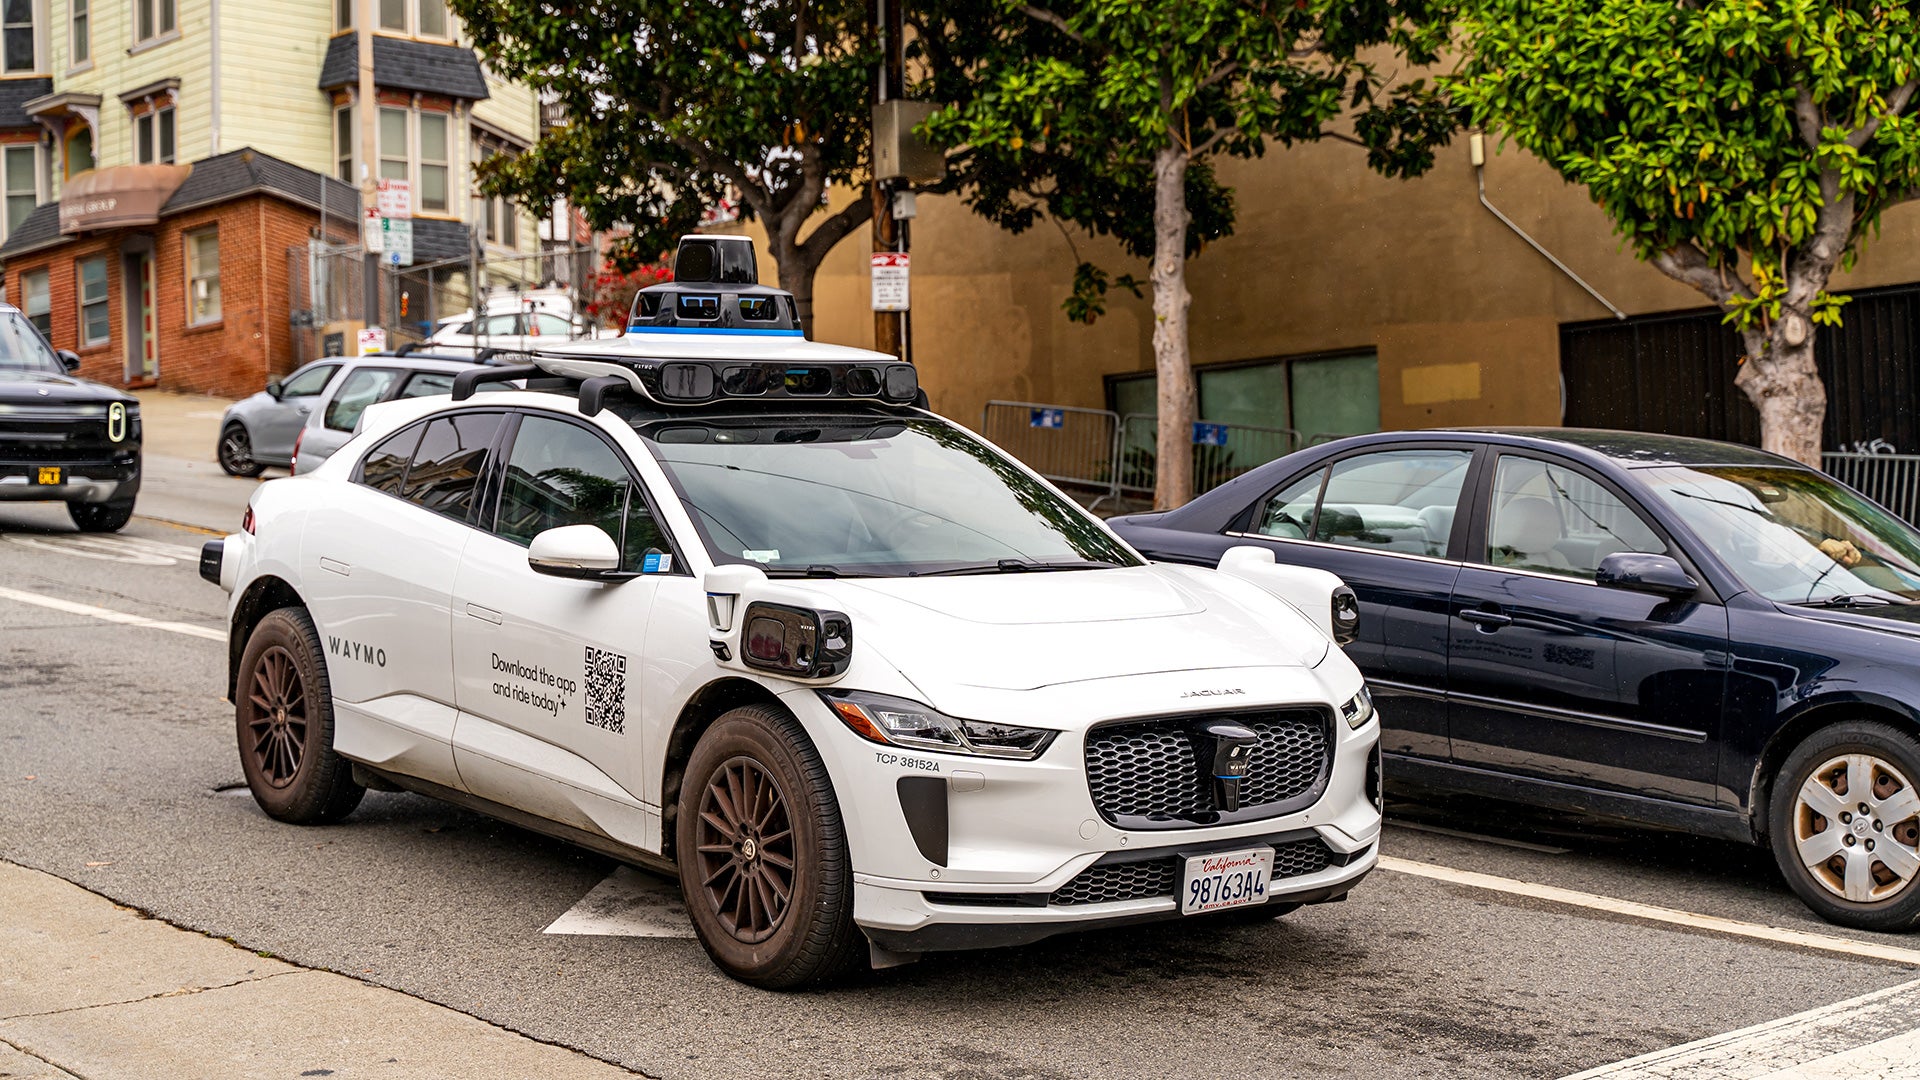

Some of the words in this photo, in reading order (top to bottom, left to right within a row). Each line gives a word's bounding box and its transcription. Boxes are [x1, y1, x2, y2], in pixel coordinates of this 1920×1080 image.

[329, 635, 386, 668] WAYMO
[491, 652, 538, 681] Download
[539, 667, 555, 687] the
[556, 677, 577, 696] app
[493, 682, 511, 698] and
[512, 685, 530, 704] ride
[531, 691, 559, 717] today
[1180, 688, 1246, 699] JAGUAR
[876, 752, 898, 765] TCP
[900, 756, 940, 773] 38152A
[1203, 857, 1256, 874] California
[1189, 870, 1265, 906] 98763A4
[1203, 898, 1248, 910] dmv.ca.gov
